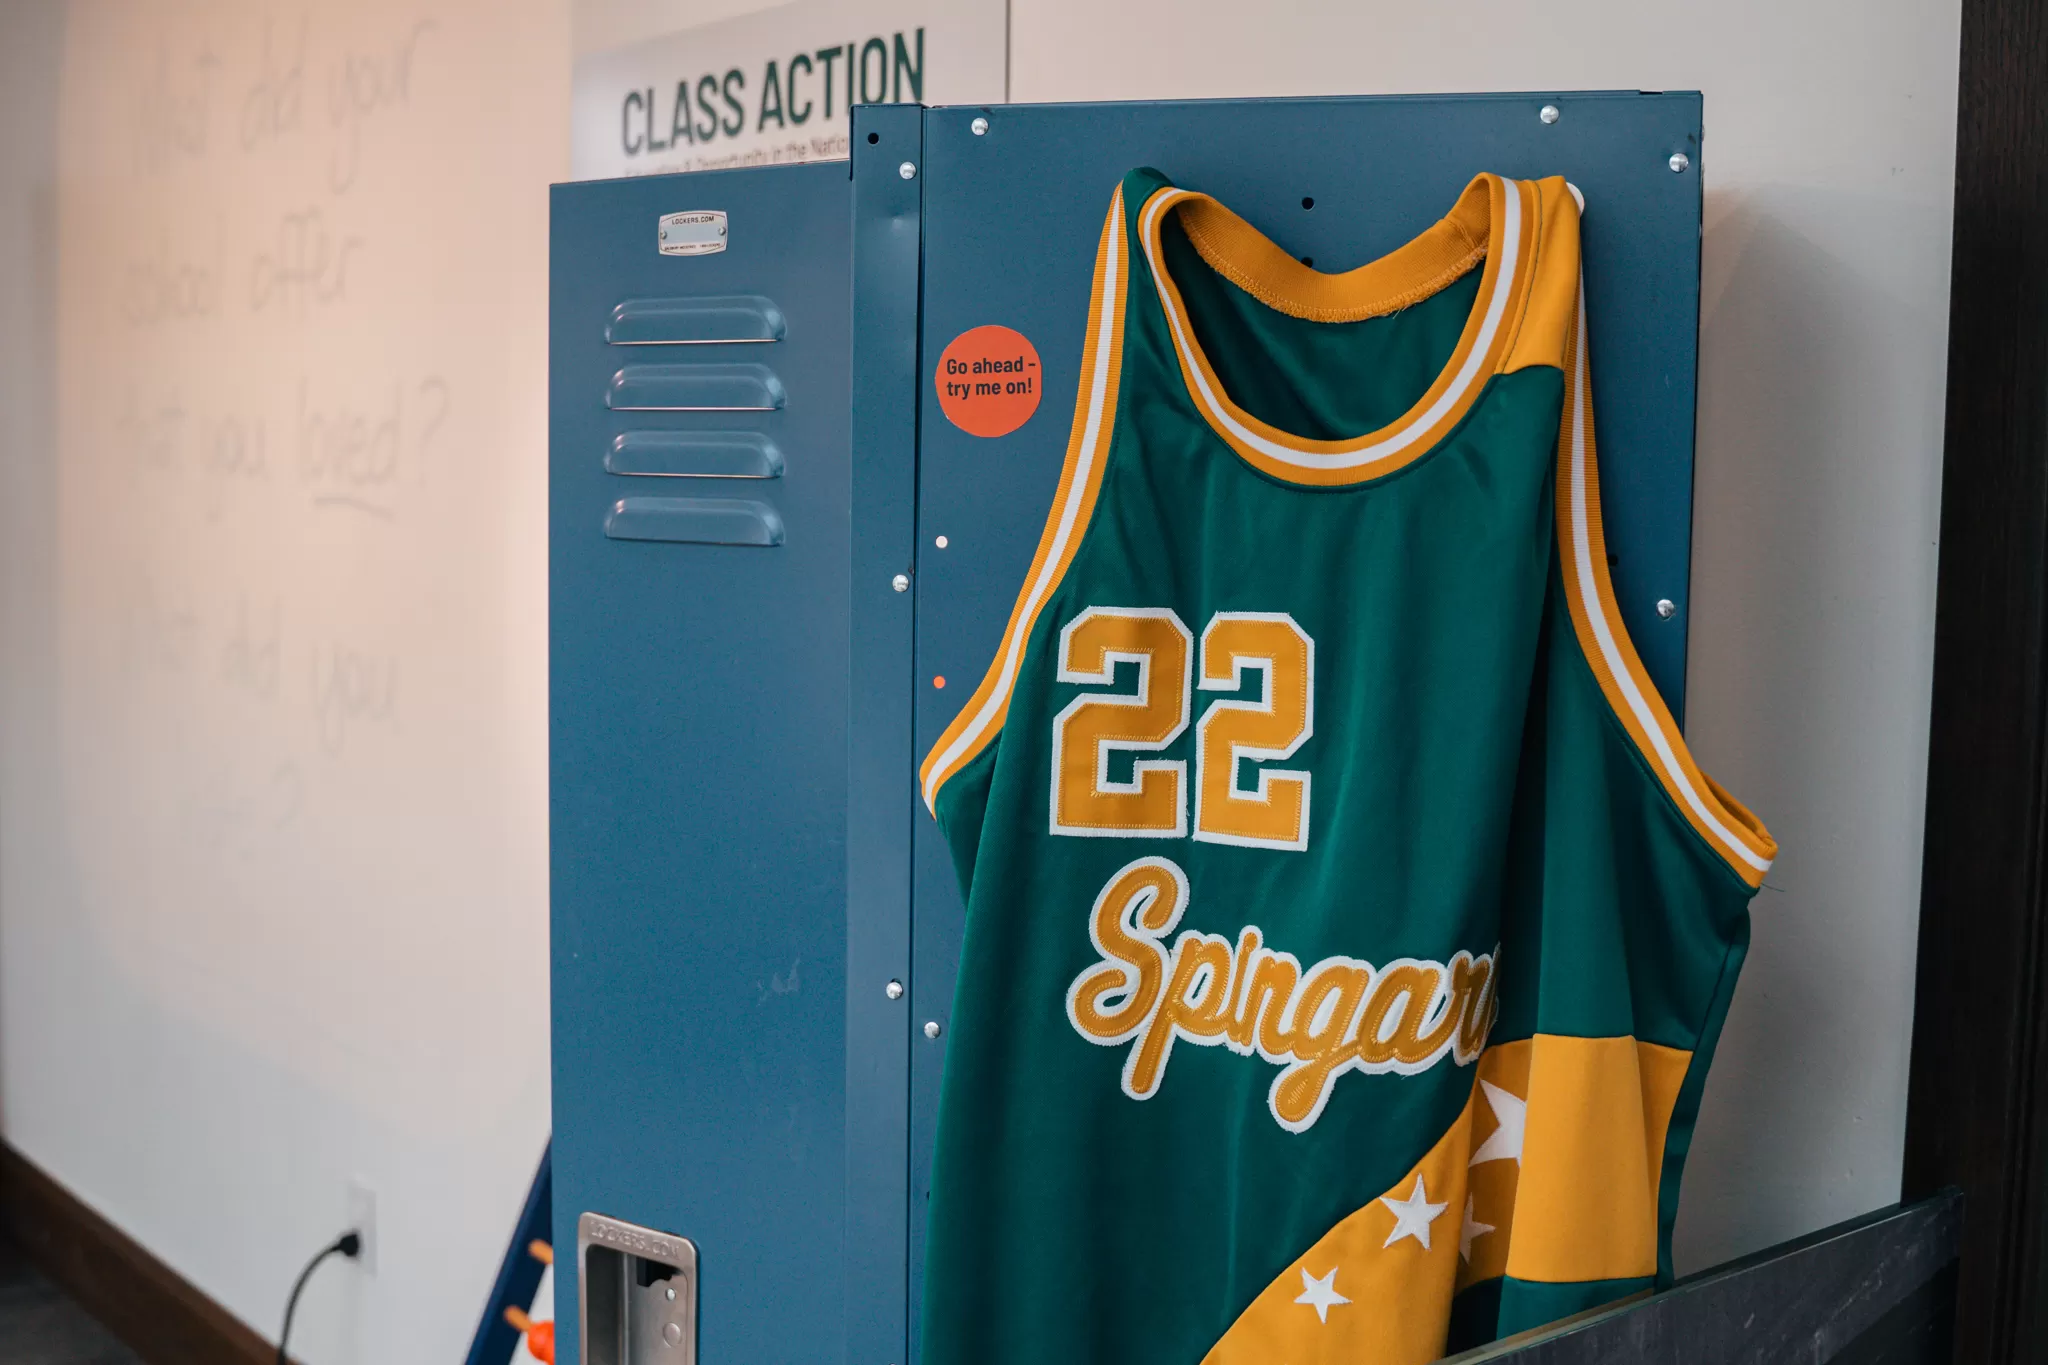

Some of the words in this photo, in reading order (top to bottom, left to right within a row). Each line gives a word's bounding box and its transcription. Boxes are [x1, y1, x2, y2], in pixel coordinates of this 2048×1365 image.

[622, 68, 746, 156] CLASS
[757, 27, 924, 132] ACTION
[671, 215, 715, 226] LOCKERS.COM
[946, 358, 968, 375] Go
[972, 356, 1024, 374] ahead
[946, 381, 971, 400] try
[975, 383, 1001, 396] me
[1005, 377, 1032, 394] on!
[1049, 605, 1315, 852] 22
[1065, 855, 1500, 1134] Spingar
[589, 1220, 681, 1261] LOCKERS.COM
